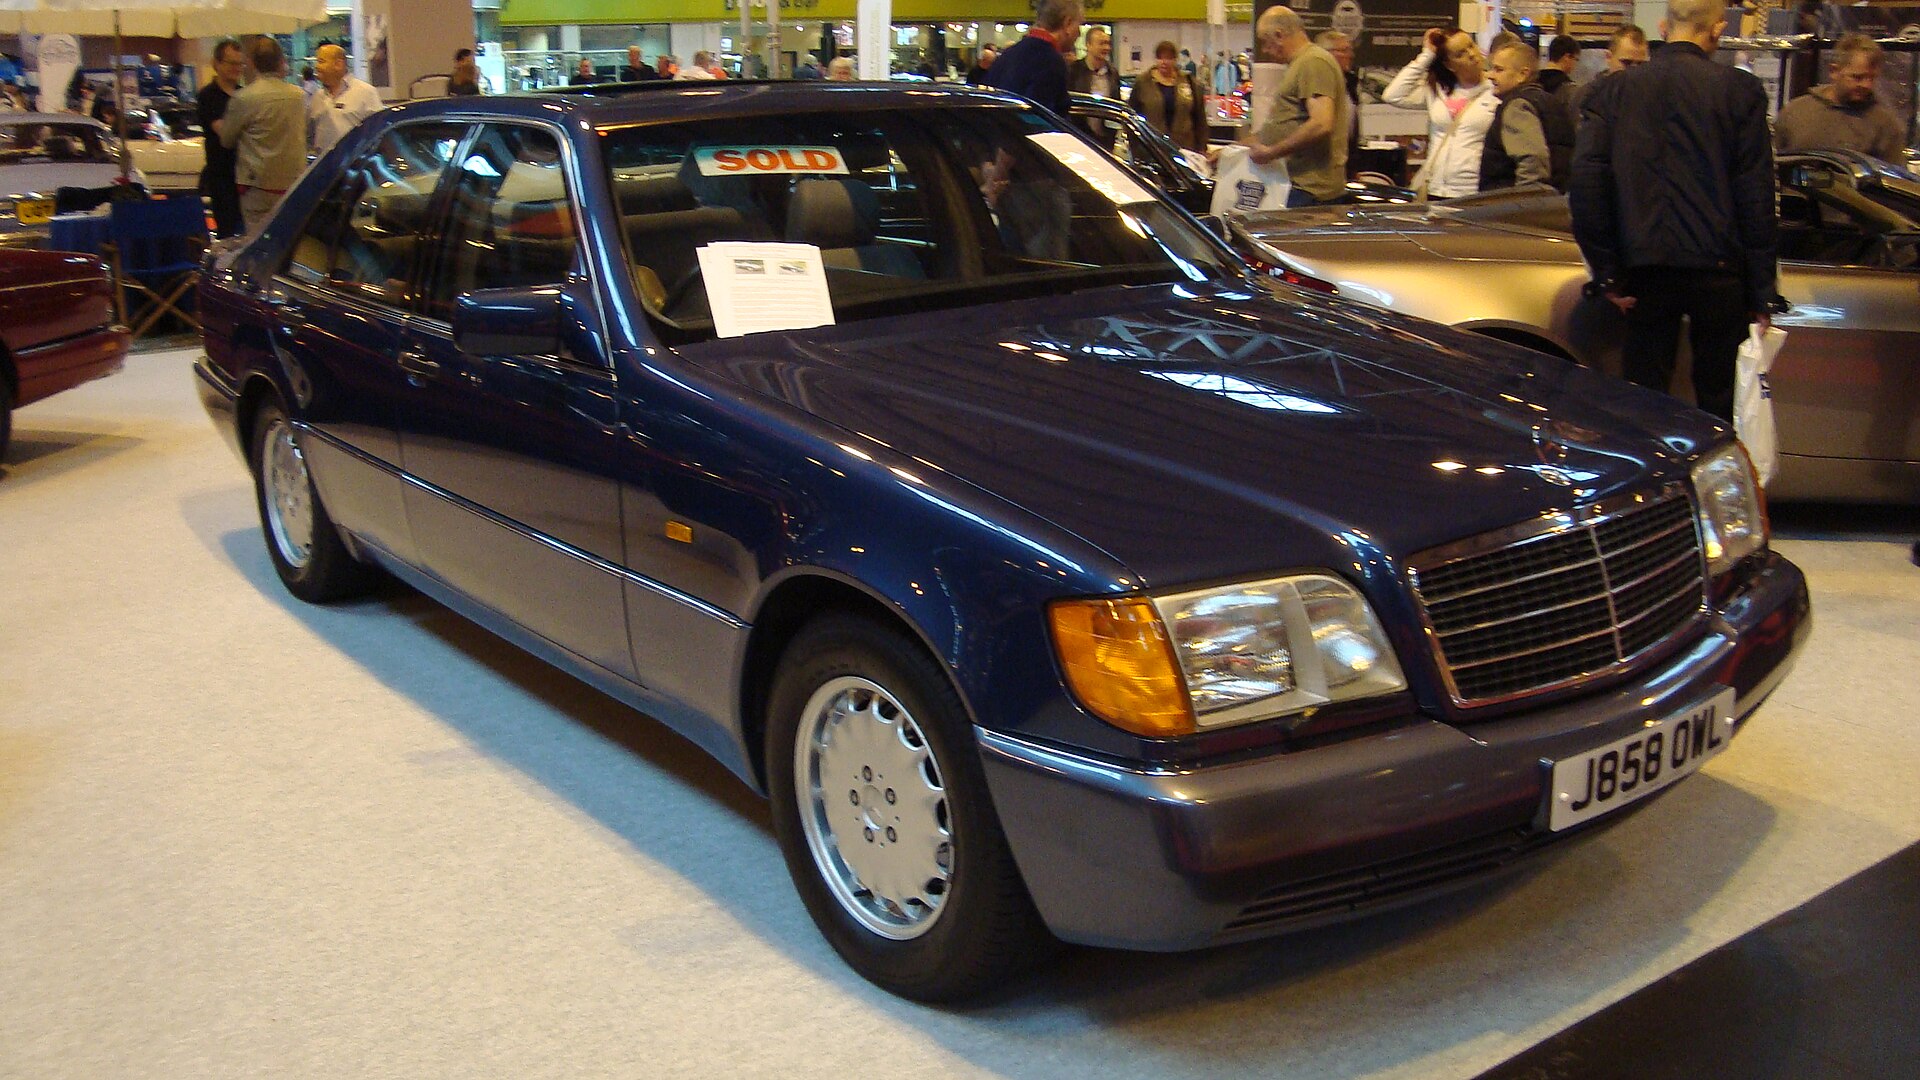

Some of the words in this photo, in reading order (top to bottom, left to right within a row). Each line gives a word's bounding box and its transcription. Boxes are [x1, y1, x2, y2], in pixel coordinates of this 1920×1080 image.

[713, 149, 837, 171] SOLD
[1571, 732, 1662, 811] J858
[1671, 705, 1721, 769] OWL
